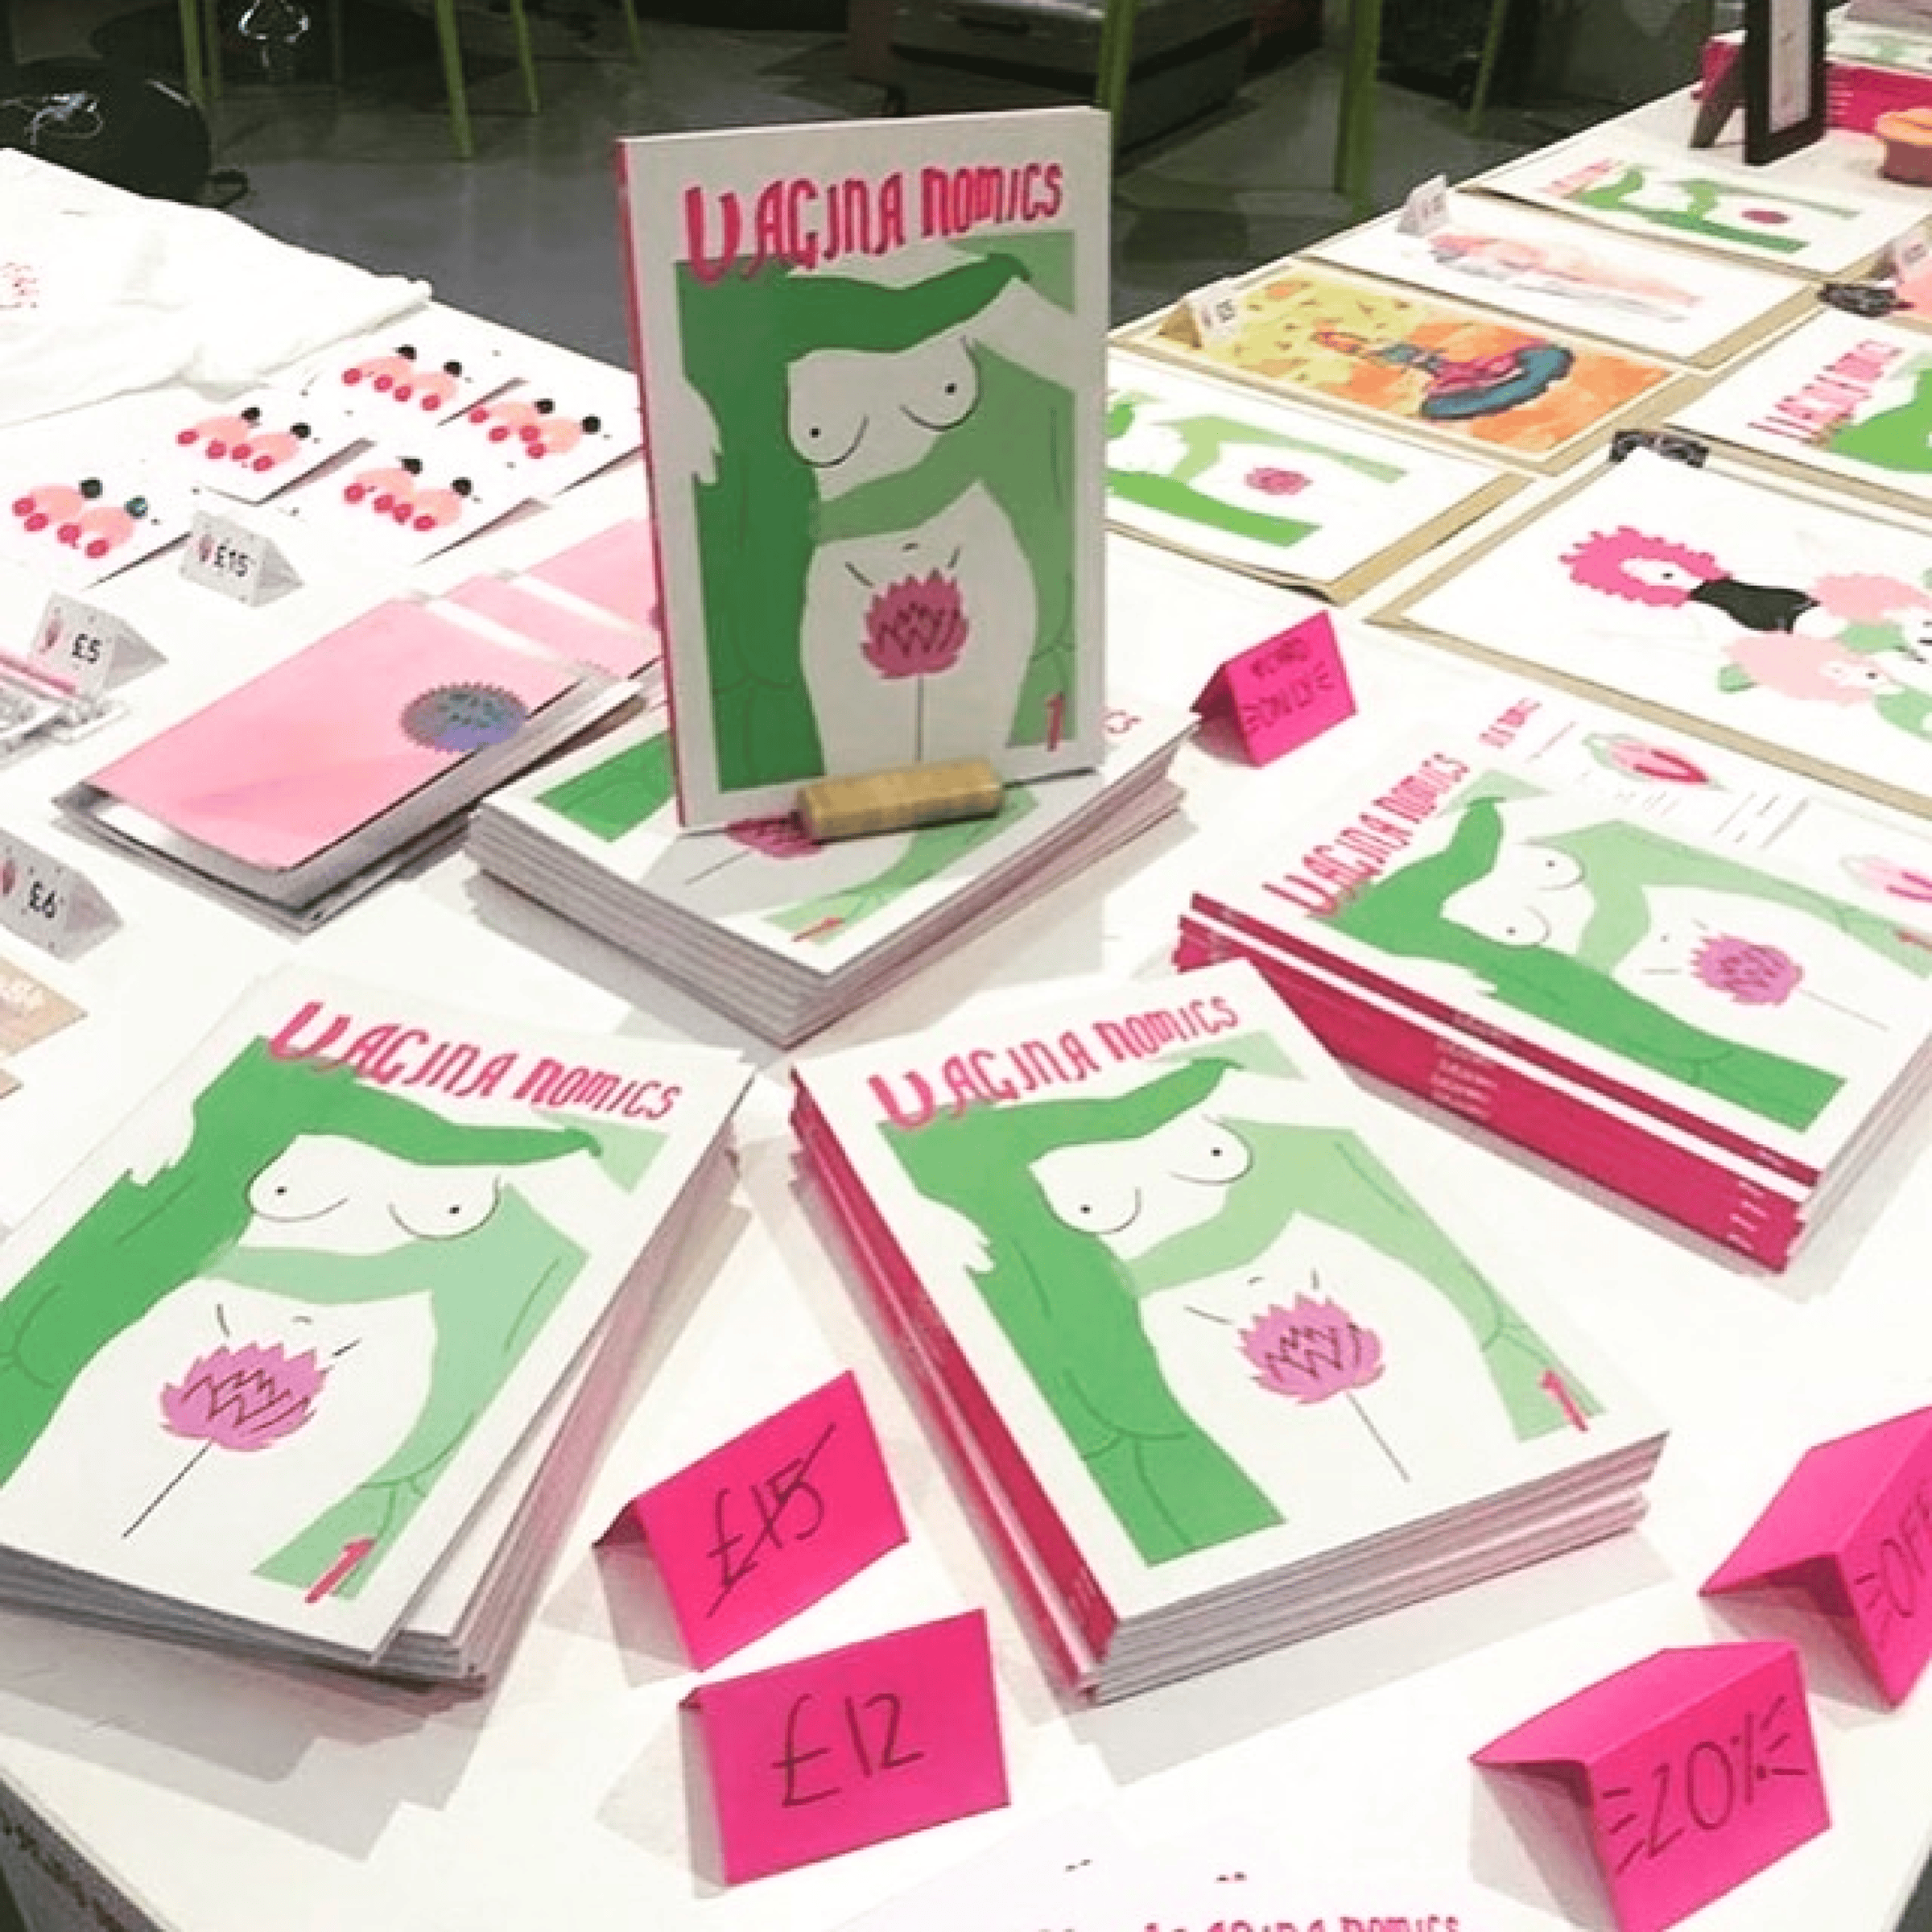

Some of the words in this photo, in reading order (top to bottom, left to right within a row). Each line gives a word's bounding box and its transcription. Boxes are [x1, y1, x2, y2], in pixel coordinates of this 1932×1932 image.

[214, 545, 249, 577] £15
[72, 633, 102, 664] £5
[1046, 691, 1066, 751] 1
[30, 881, 56, 918] £6
[1539, 1369, 1589, 1433] 1
[304, 1536, 377, 1604] 1
[771, 1692, 925, 1807] £12
[1647, 1711, 1768, 1859] 20%
